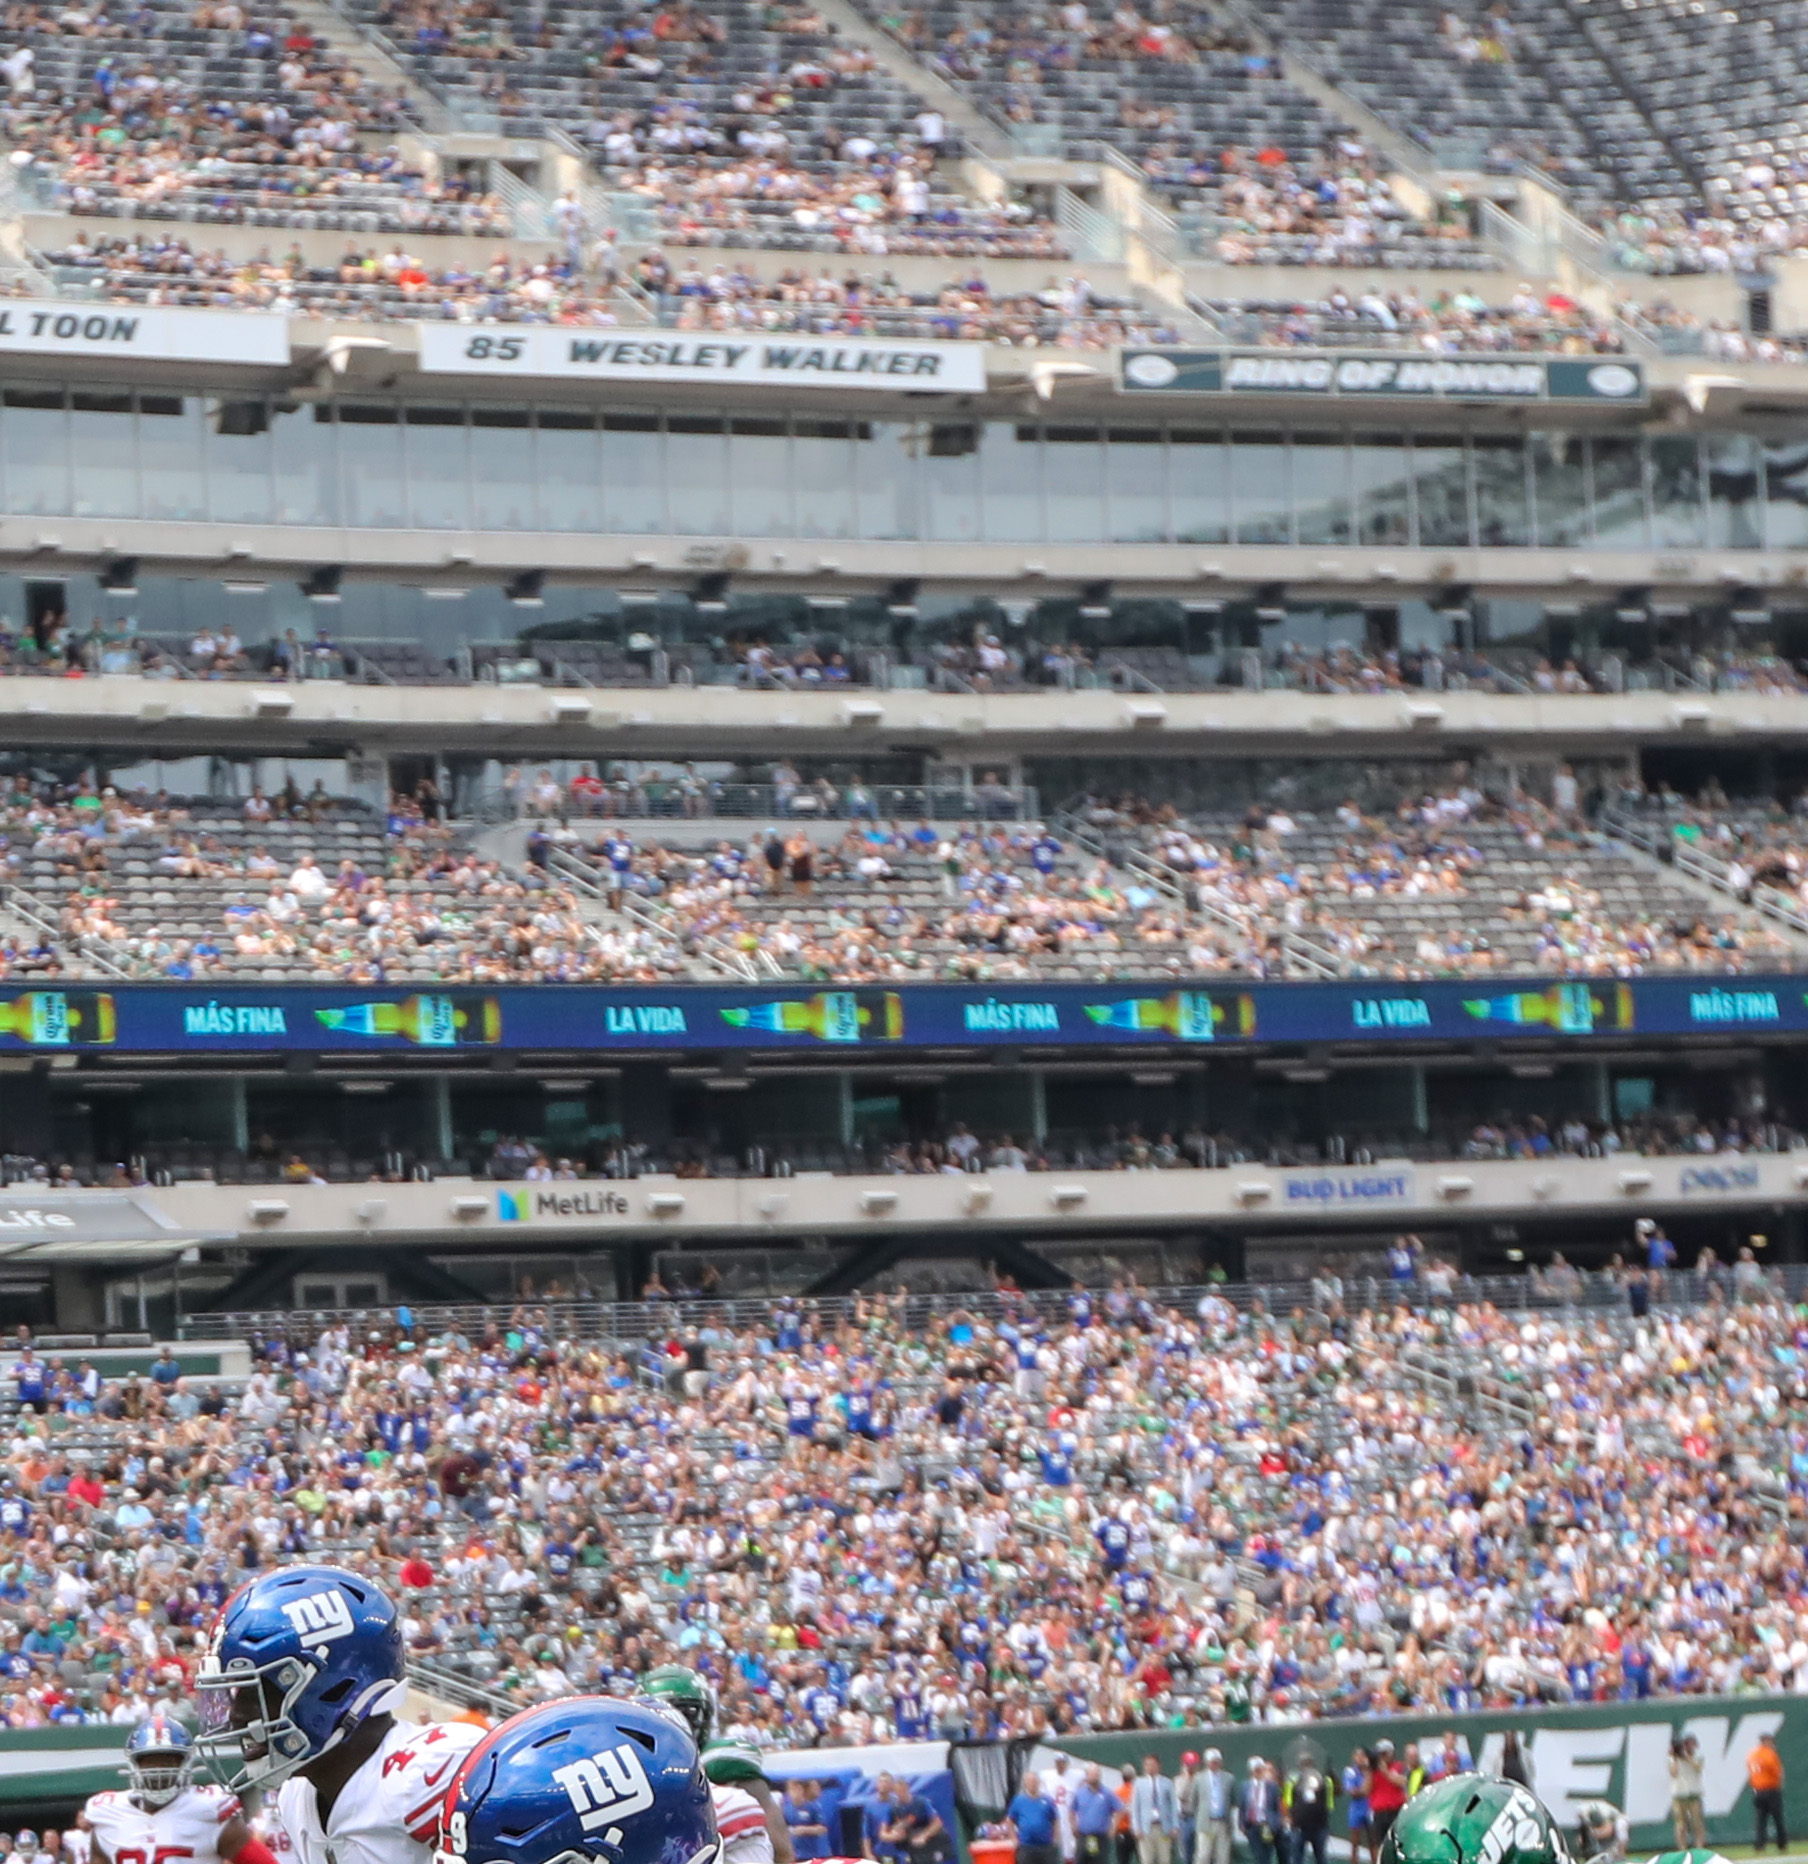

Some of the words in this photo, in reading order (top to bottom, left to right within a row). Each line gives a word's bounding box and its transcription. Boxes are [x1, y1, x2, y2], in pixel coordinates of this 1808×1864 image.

[28, 311, 140, 343] TOON
[465, 335, 526, 362] 85
[568, 338, 752, 369] WESLEY
[762, 343, 941, 376] WALKER
[1226, 356, 1331, 388] RING
[1338, 359, 1393, 390] OF
[1397, 361, 1543, 394] HONOR
[184, 1001, 236, 1036] MÁS
[238, 1005, 286, 1037] FINA
[606, 1004, 634, 1033] LA
[637, 1005, 686, 1034] VIDA
[1015, 1001, 1059, 1032] FINA
[1353, 997, 1380, 1029] LA
[1383, 997, 1431, 1029] VIDA
[1286, 1176, 1336, 1202] BUD
[1341, 1173, 1406, 1201] LIGHT
[1680, 1163, 1760, 1196] pepsi
[536, 1190, 630, 1220] MetLife
[281, 1590, 355, 1648] ny
[551, 1743, 654, 1831] ny
